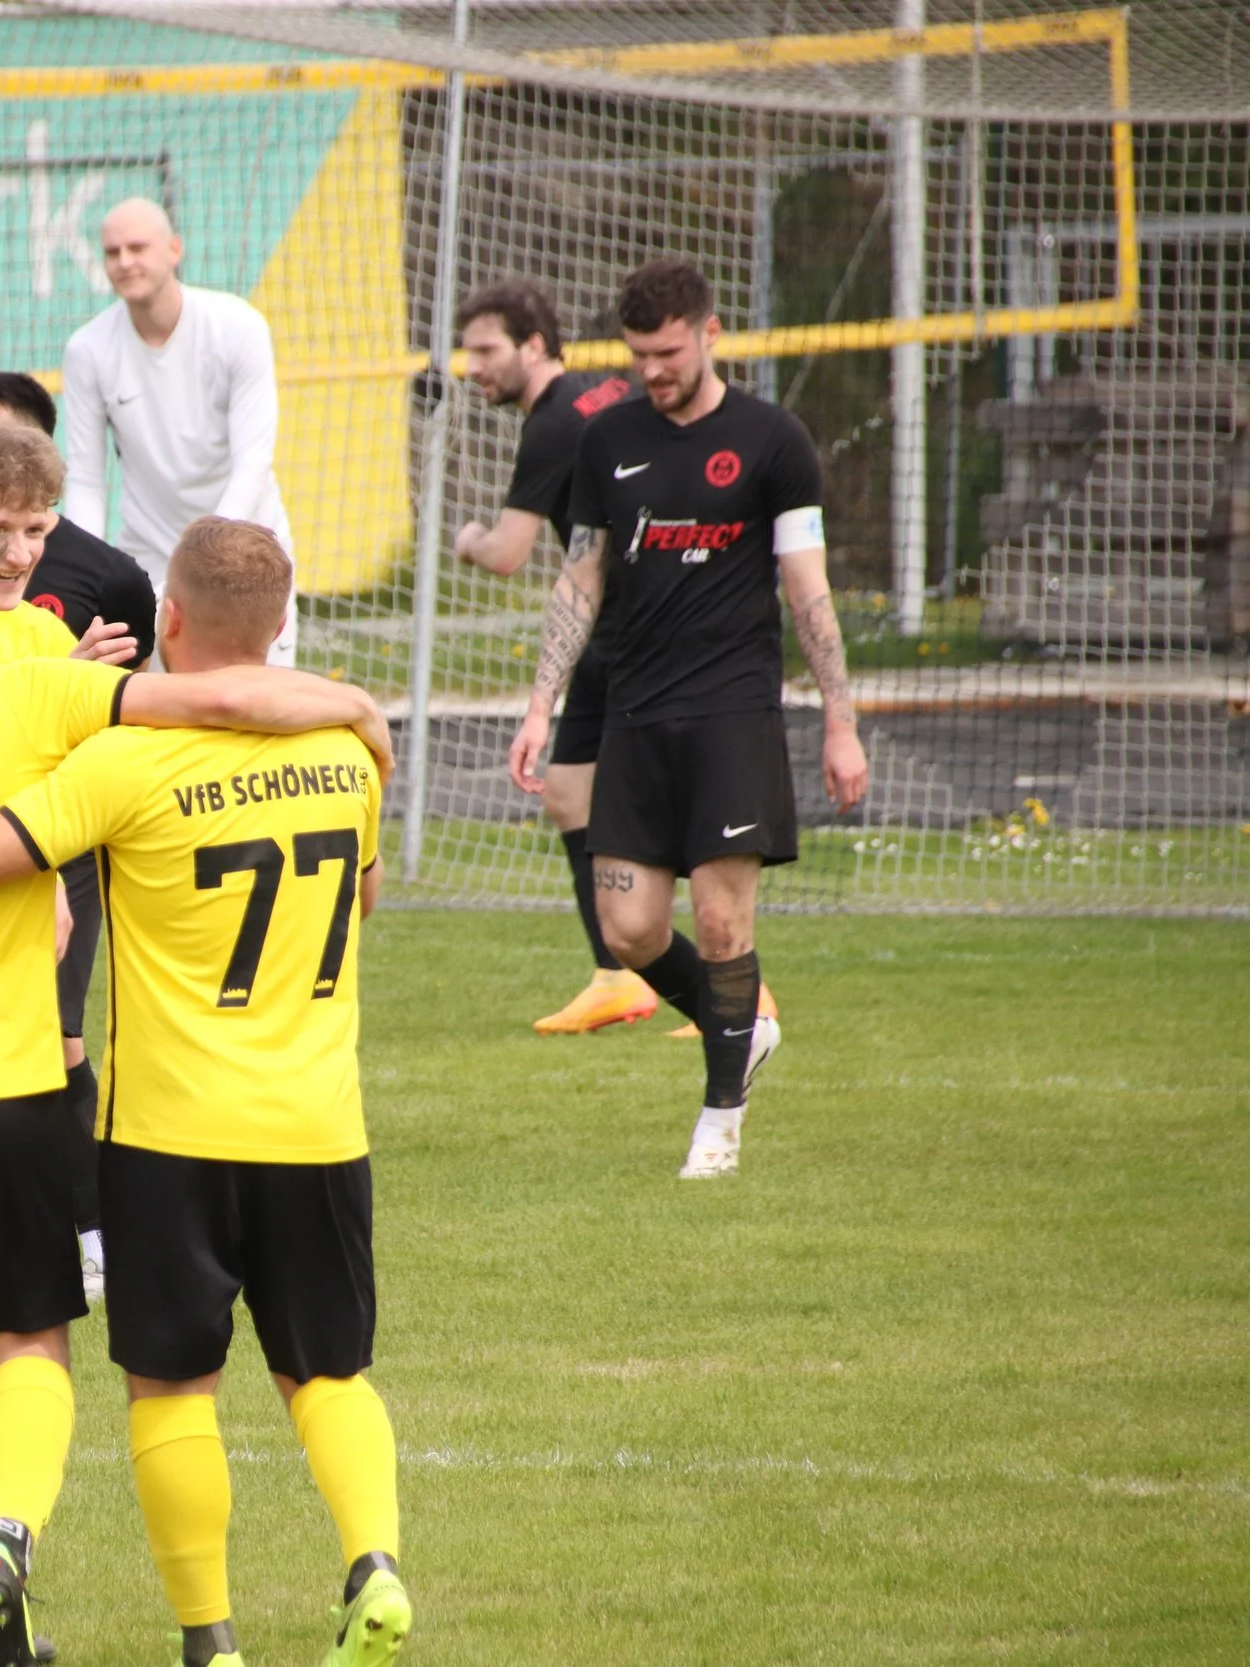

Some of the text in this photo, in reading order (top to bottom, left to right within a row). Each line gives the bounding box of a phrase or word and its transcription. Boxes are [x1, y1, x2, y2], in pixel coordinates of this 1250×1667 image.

[173, 763, 360, 818] VfB SCHÖNECK
[359, 766, 369, 796] 1912
[193, 826, 360, 1009] 77
